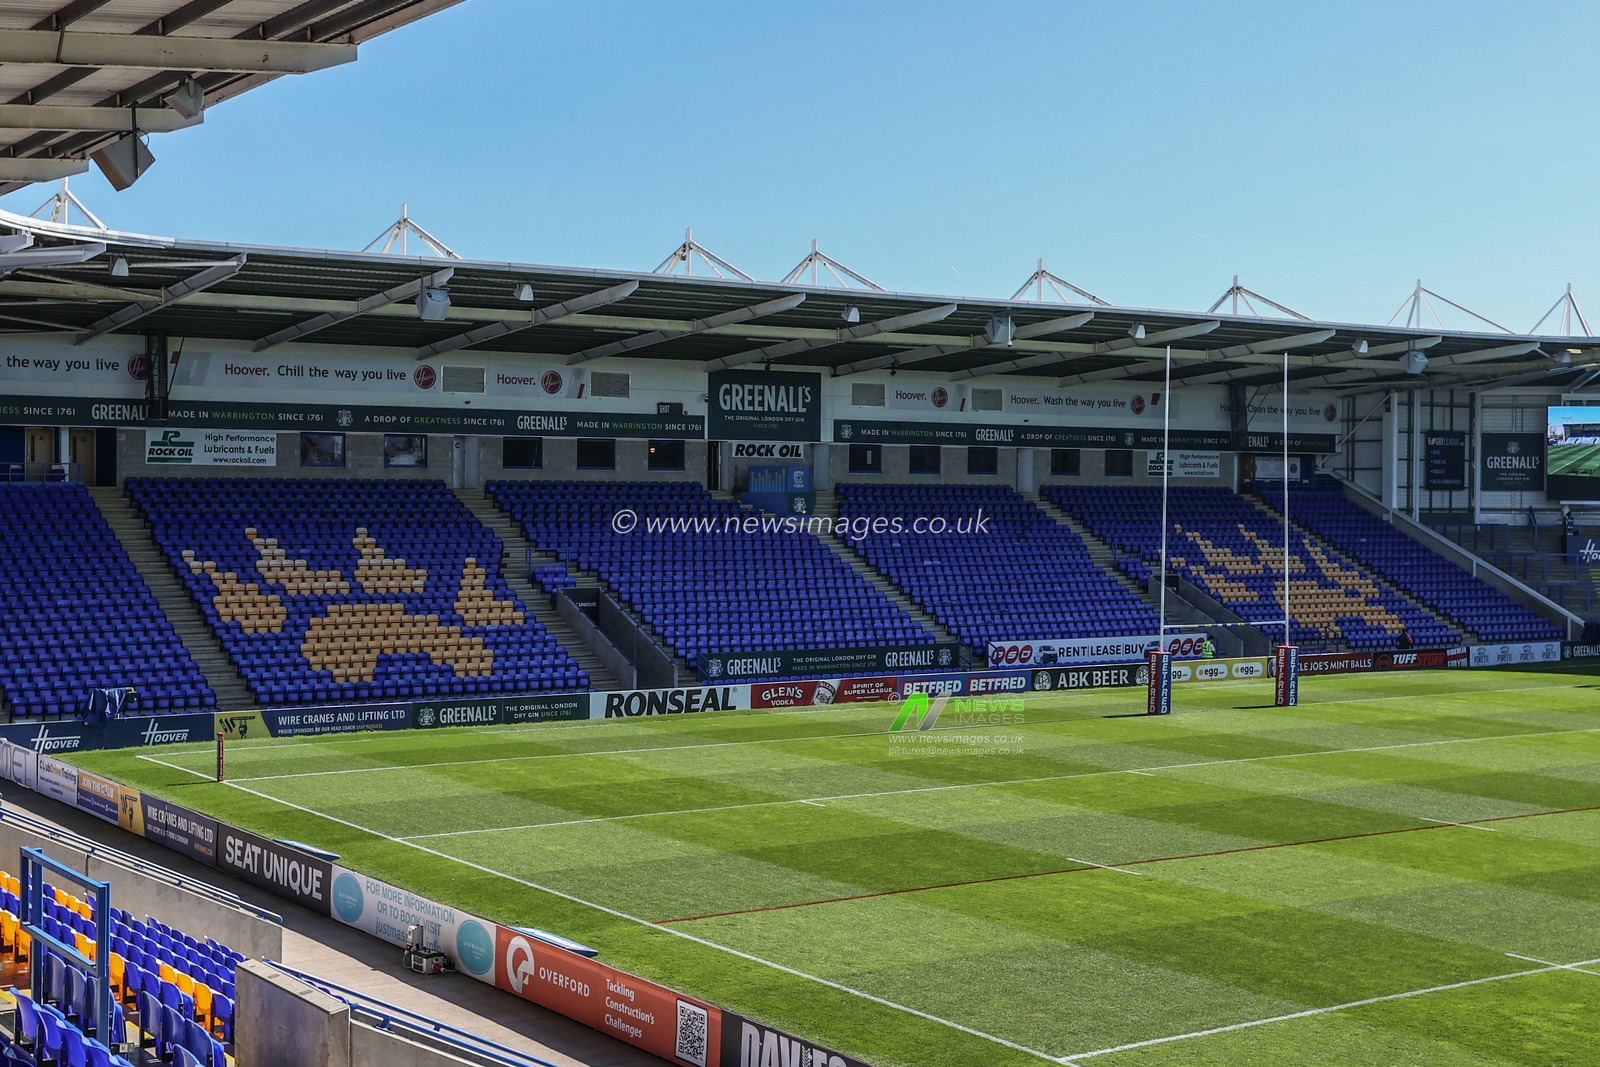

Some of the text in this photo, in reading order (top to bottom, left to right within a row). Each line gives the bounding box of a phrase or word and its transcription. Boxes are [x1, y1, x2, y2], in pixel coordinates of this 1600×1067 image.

[7, 355, 29, 368] the
[34, 358, 60, 372] way
[66, 359, 90, 373] you
[96, 357, 119, 371] live
[225, 363, 407, 382] Hoover. Chill the way you live
[497, 373, 536, 386] Hoover.
[719, 383, 811, 412] GREENALL'S
[895, 390, 927, 401] Hoover.
[1010, 395, 1126, 410] Hoover. Wash the way you live
[23, 406, 76, 416] SINCE 1761
[168, 409, 323, 422] MADE IN WARRINGTON SINCE 1761
[1248, 404, 1321, 417] Clean the you live
[373, 415, 397, 423] DROP
[400, 416, 411, 424] OF
[414, 417, 461, 425] GREATNESS
[463, 417, 487, 426] SINCE
[489, 418, 505, 426] 1761
[517, 415, 567, 431] GREENALL'S
[577, 421, 599, 429] MADE
[601, 421, 609, 429] IN
[612, 422, 663, 430] WARRINGTON
[665, 423, 686, 431] SINCE
[205, 434, 275, 443] High Performance
[861, 428, 880, 436] MADE
[891, 429, 934, 438] WARRINGTON
[935, 430, 953, 438] SINCE
[955, 430, 967, 438] 1761
[975, 428, 1014, 442] GREENALL'S
[1088, 434, 1103, 442] SINCE
[148, 447, 193, 457] ROCK OIL
[204, 444, 275, 455] Lubricants & Fuels
[735, 443, 802, 458] ROCK OIL
[1179, 453, 1219, 462] High Performance
[213, 456, 266, 465] www.rockoil.com
[1179, 462, 1201, 470] Lubricants
[1487, 456, 1540, 469] GREENALL'S
[1058, 643, 1145, 658] RENT LEASE BUY
[1393, 653, 1417, 664] TUFF
[727, 656, 782, 676] GREENALL'S
[885, 650, 935, 668] GREENALL'S
[1310, 660, 1329, 671] JOE'S
[1331, 659, 1350, 670] MINT
[1351, 657, 1372, 669] BALLS
[969, 676, 1026, 692] BETFRED
[1057, 669, 1130, 688] ABK BEER
[1149, 654, 1157, 714] BETFRED
[1160, 654, 1169, 714] BETFRED
[1277, 648, 1285, 706] BETFRED
[1289, 648, 1297, 706] BETFRED
[761, 686, 804, 701] GLEN'S
[867, 686, 893, 694] LEAGUE
[903, 679, 962, 696] BETFRED
[604, 688, 737, 719] RONSEAL
[771, 697, 795, 706] VODKA
[278, 709, 405, 726] WIRE CRANES AND LIFTING LTD
[440, 704, 497, 724] GREENALL'S
[30, 724, 81, 753] HOOVER
[141, 718, 190, 746] HOOVER
[82, 776, 92, 790] JOIN
[92, 780, 101, 794] THE
[147, 804, 214, 844] WIRE CRANES AND LIFTING LTD
[225, 835, 323, 901] SEAT UNIQUE
[365, 880, 380, 898] FOR
[381, 885, 403, 906] MORE
[403, 890, 455, 925] INFORMATION
[377, 901, 442, 937] OR TO BOOK VISIT
[539, 965, 590, 998] OVERFORD
[605, 978, 635, 1001] Tackling
[605, 996, 655, 1025] Construction's
[604, 1014, 643, 1038] Challenges
